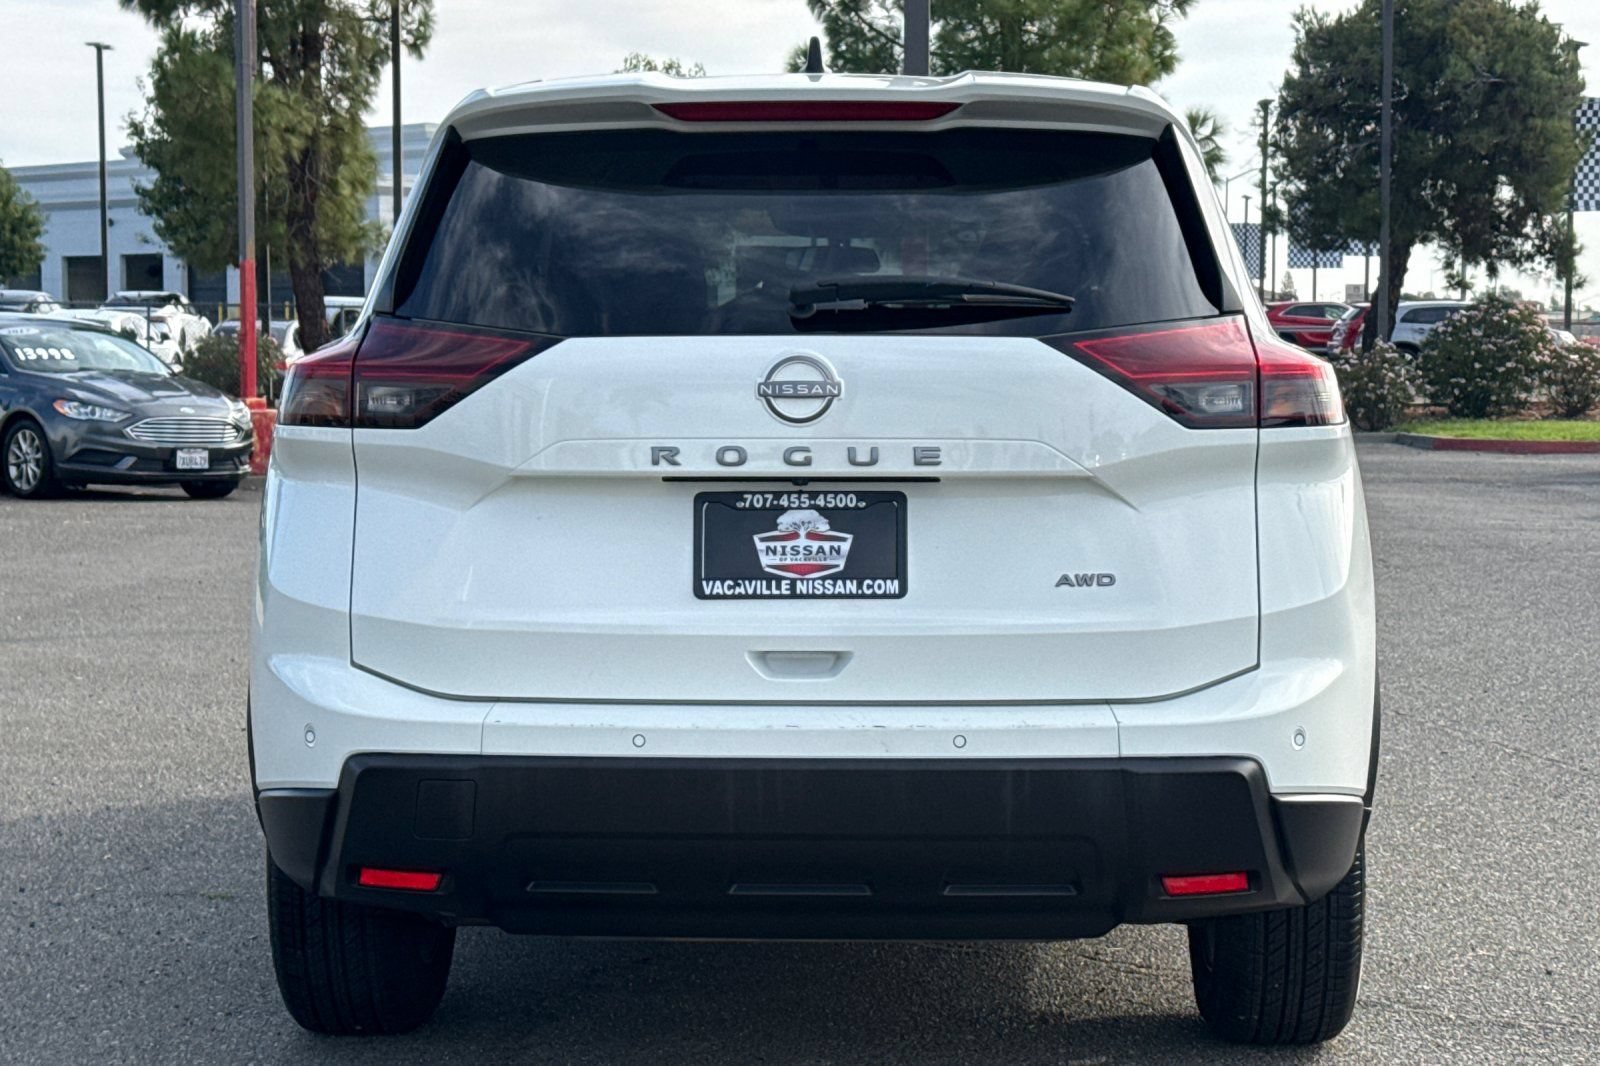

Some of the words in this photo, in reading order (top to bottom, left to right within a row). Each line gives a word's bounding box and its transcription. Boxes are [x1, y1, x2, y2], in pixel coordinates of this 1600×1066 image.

[760, 384, 839, 395] NISSAN
[650, 446, 943, 467] ROGUE
[743, 493, 857, 508] 707-455-4500
[765, 545, 842, 557] NISSAN
[796, 579, 899, 595] NISSAN.COM
[1054, 573, 1116, 587] AWD
